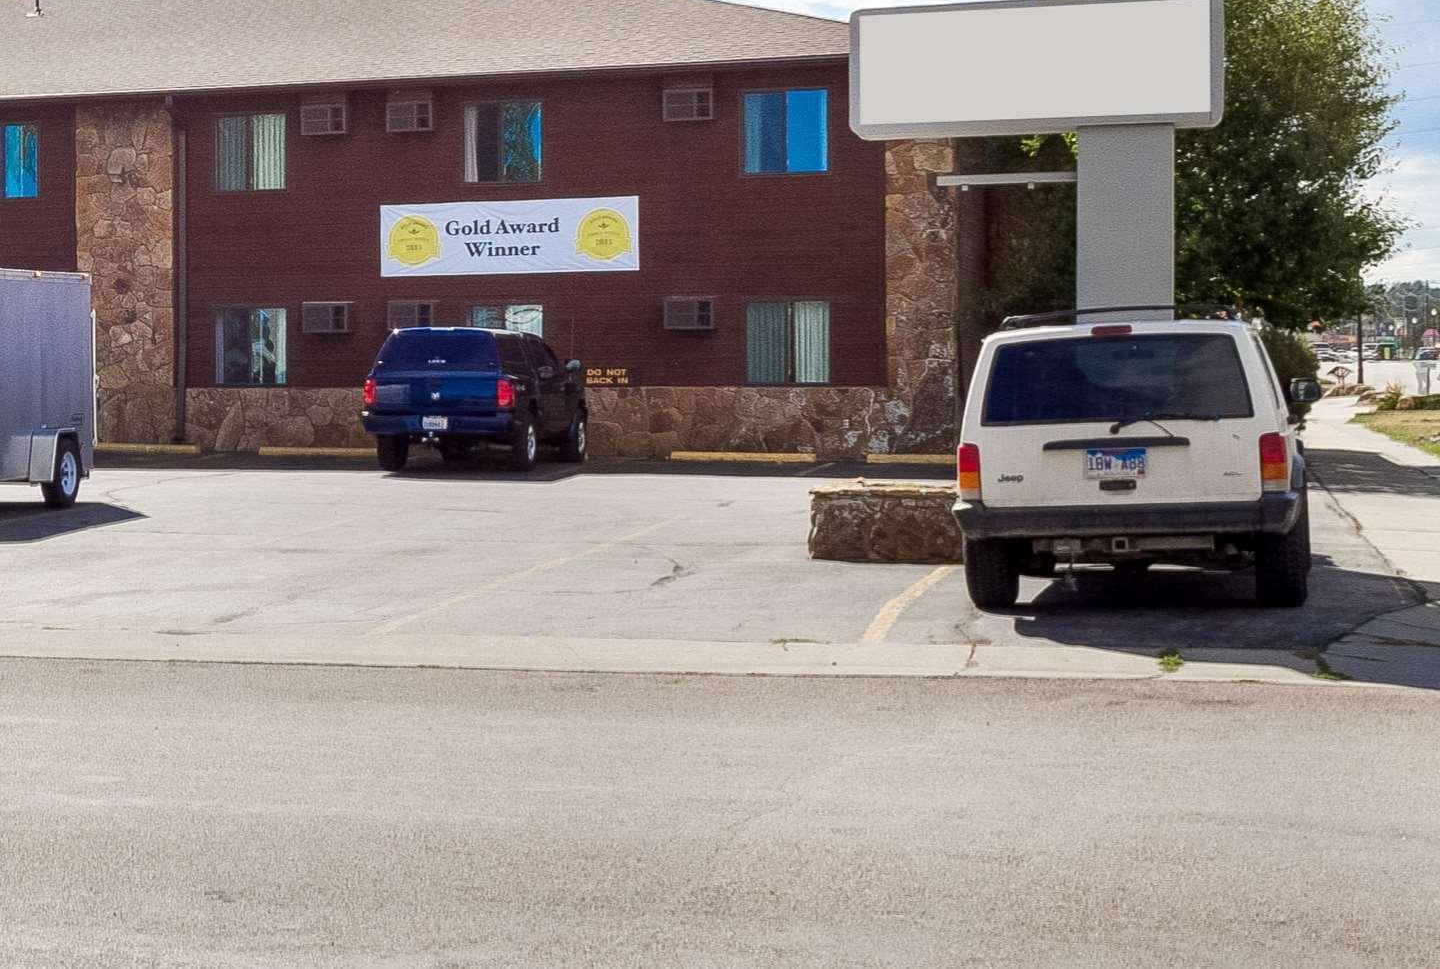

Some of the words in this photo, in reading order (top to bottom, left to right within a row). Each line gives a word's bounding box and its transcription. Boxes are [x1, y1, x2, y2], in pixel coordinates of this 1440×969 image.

[445, 219, 493, 236] Gold
[495, 217, 560, 235] Award
[464, 242, 540, 258] Winner
[587, 368, 602, 376] DO
[607, 368, 626, 376] NOT
[997, 473, 1024, 484] Jeep
